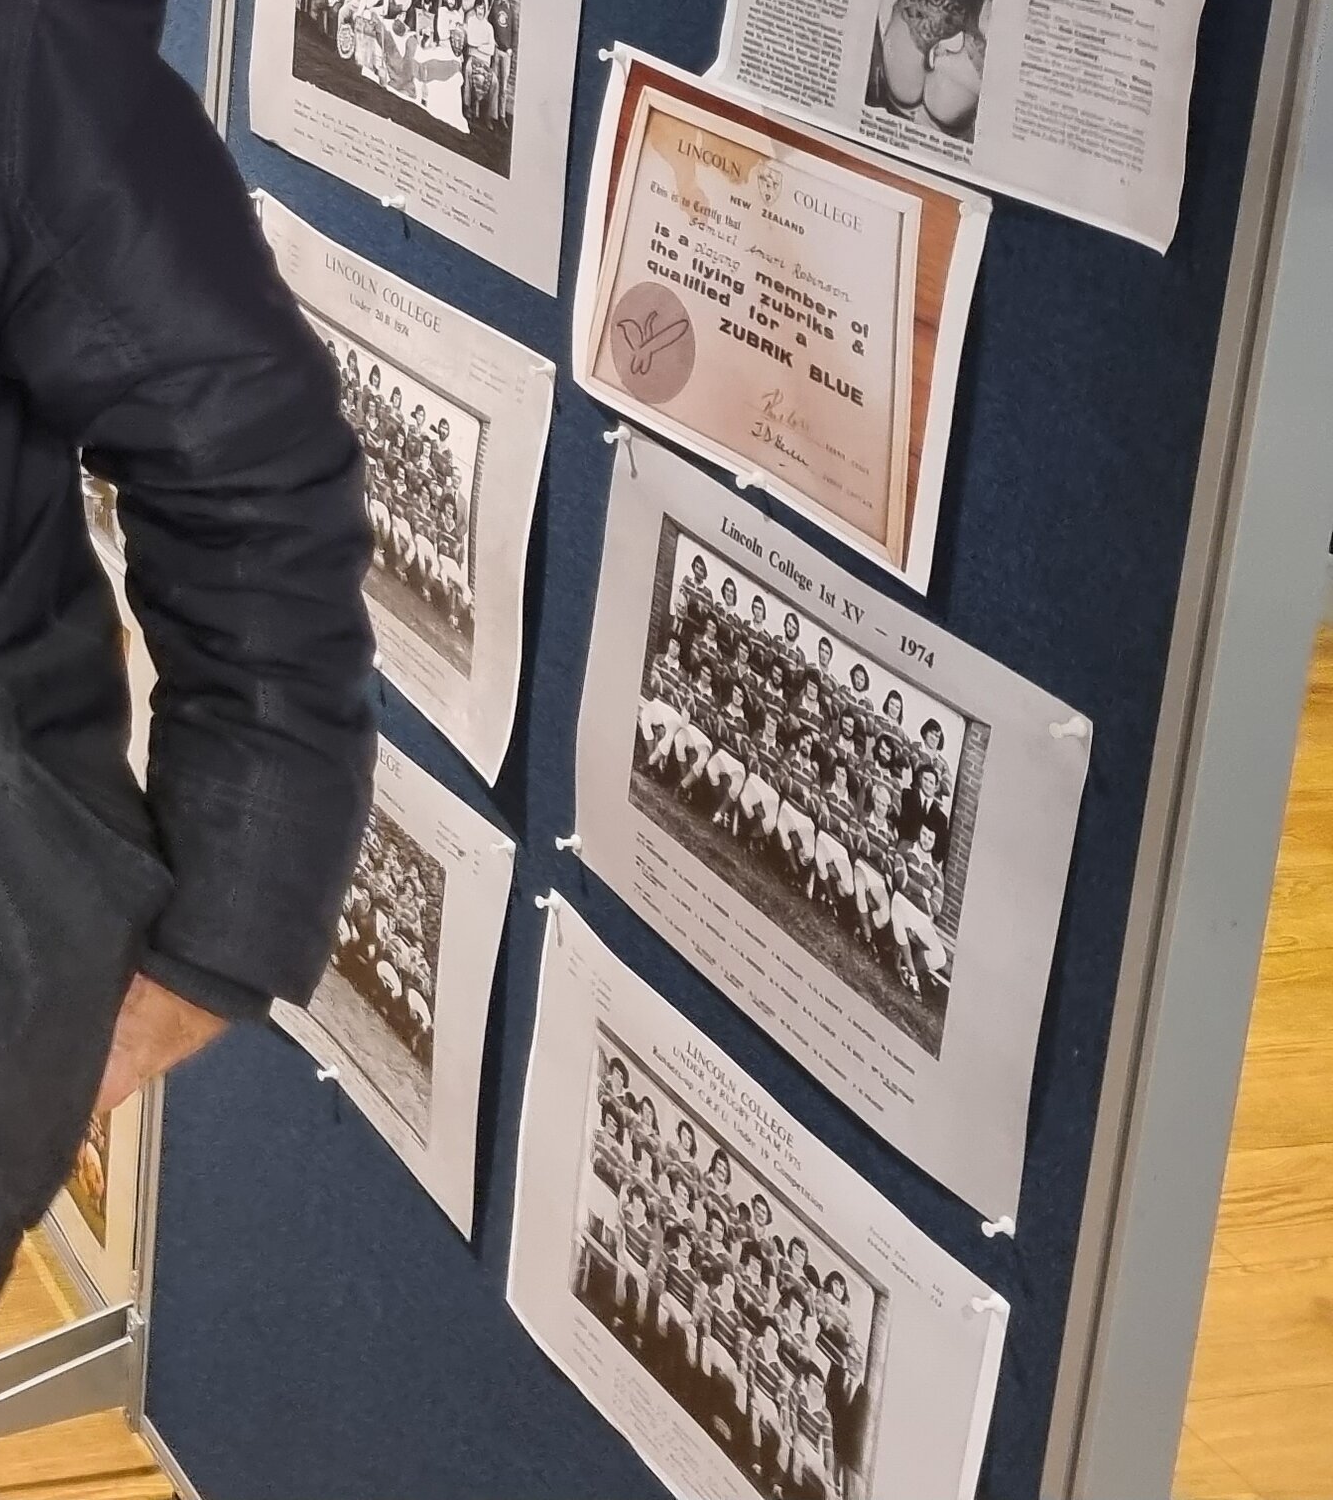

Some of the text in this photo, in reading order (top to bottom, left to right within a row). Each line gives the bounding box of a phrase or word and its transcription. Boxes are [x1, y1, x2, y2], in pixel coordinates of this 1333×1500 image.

[650, 181, 668, 198] This
[725, 214, 741, 230] that
[677, 139, 863, 233] LINCOLN COLLEGE
[730, 195, 805, 235] NEW ZEALAND
[325, 252, 442, 333] LINCOLN COLLEGE
[647, 258, 807, 347] qualified for a
[650, 239, 865, 356] the flying zubriks &
[654, 222, 670, 238] is
[678, 234, 689, 247] a
[755, 271, 837, 319] member
[851, 320, 869, 339] of
[719, 316, 864, 406] ZUBRIK BLUE
[721, 516, 764, 558] Lincoln
[769, 549, 813, 591] College
[818, 581, 836, 609] 1st
[841, 598, 865, 626] XV
[898, 635, 935, 669] 1974
[673, 1046, 705, 1081] UNDER
[754, 1120, 781, 1153] TEAM
[687, 1041, 794, 1149] LINCOLN COLLEGE
